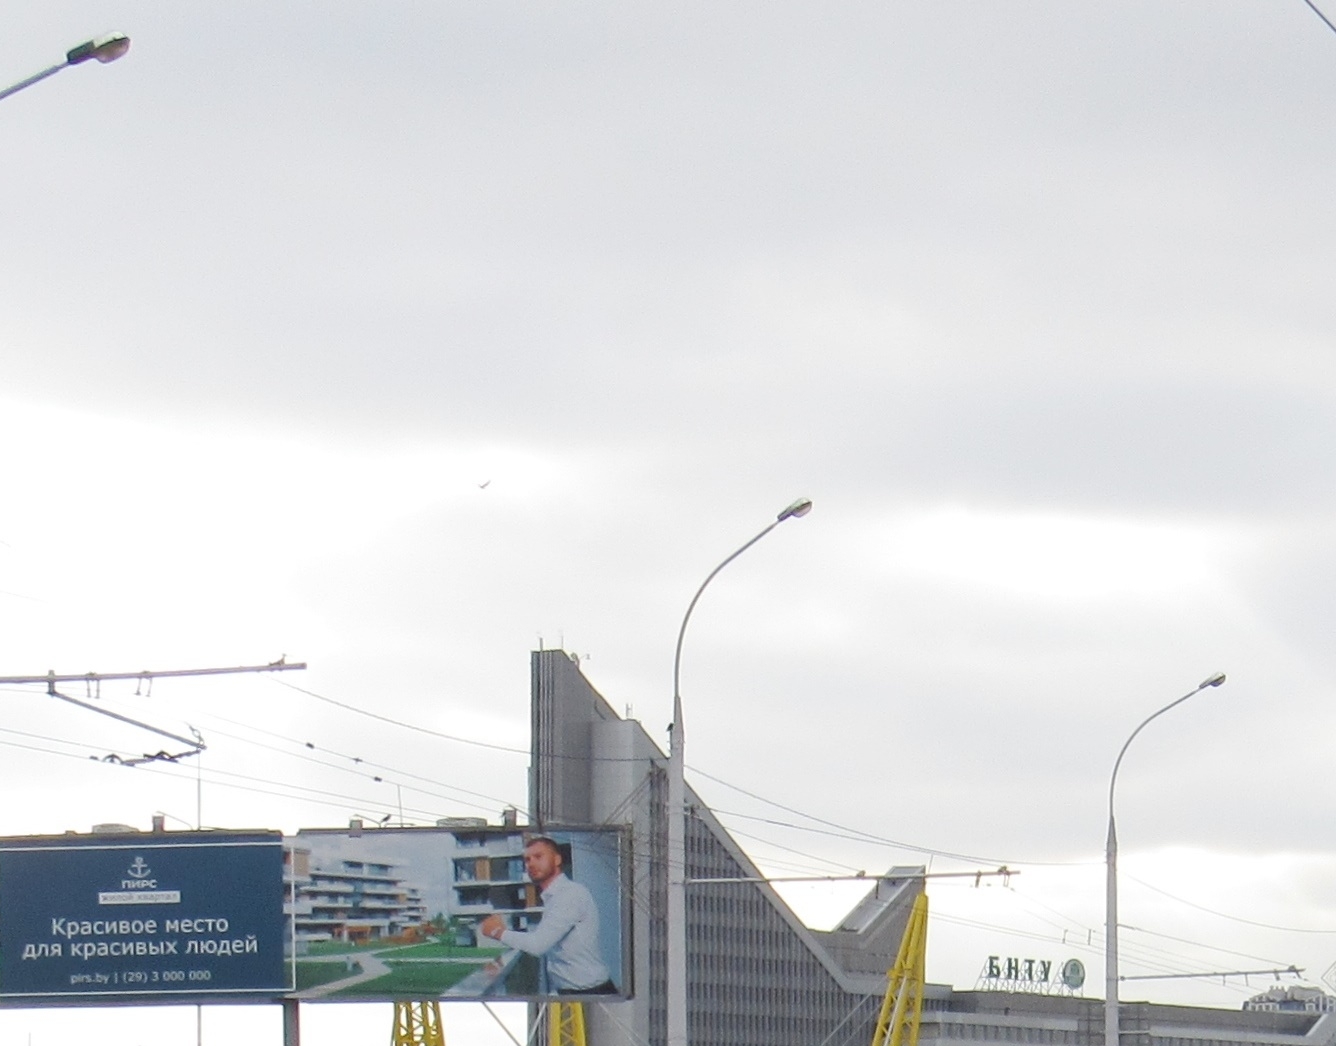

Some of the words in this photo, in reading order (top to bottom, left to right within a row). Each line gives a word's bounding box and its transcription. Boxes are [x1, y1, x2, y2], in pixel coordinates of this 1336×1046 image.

[121, 879, 158, 889] ПИРС
[52, 918, 158, 938] Красивое
[165, 917, 229, 934] место
[22, 943, 62, 960] для
[71, 941, 178, 959] красивых
[185, 935, 258, 956] людей
[70, 973, 110, 985] pirs.by
[123, 970, 148, 984] (29)
[152, 971, 160, 982] 3
[163, 971, 185, 982] 000
[189, 969, 211, 981] 000
[988, 955, 1052, 982] БНТУ
